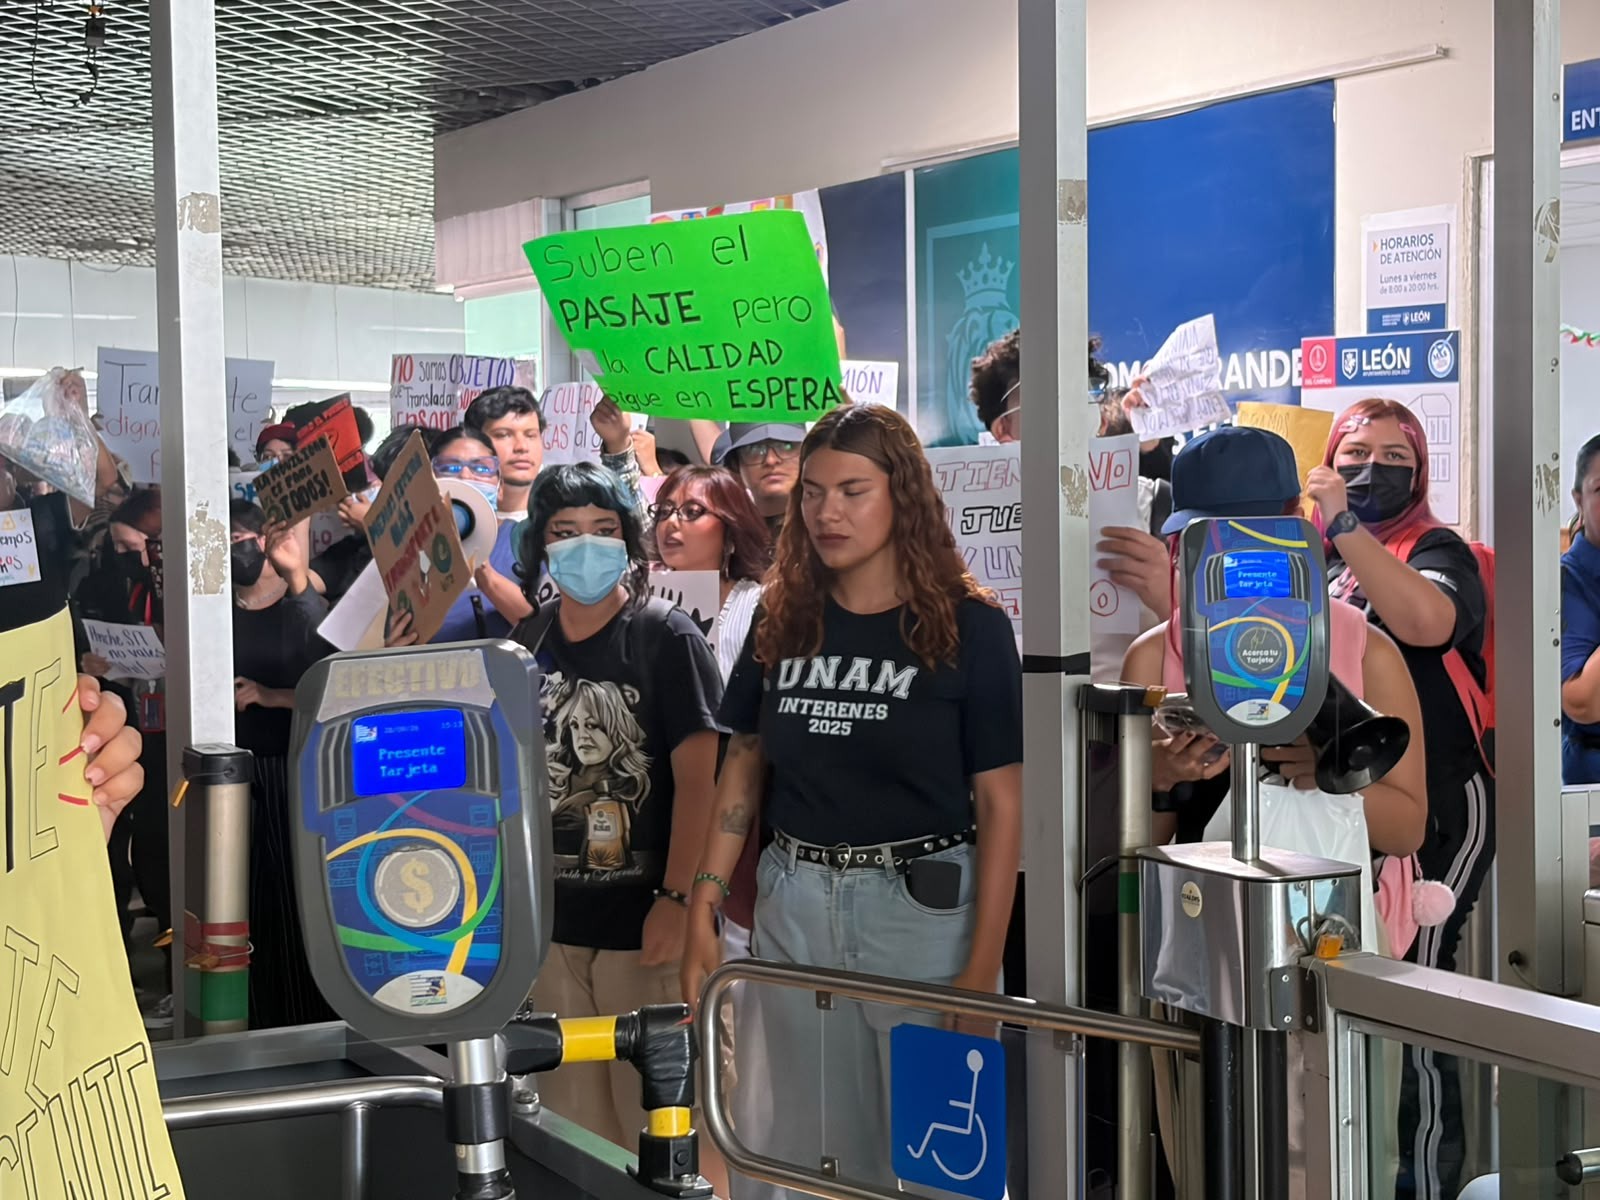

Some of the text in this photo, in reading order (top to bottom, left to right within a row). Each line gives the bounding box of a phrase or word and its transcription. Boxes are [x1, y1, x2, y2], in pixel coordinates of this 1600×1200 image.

[1380, 233, 1434, 251] HORARIOS
[543, 224, 749, 282] Suben el
[1380, 246, 1442, 265] DE ATENCIÓN
[1380, 271, 1437, 284] Lunes a viernes
[558, 289, 812, 333] PASAJE pero
[1410, 309, 1431, 322] LEÓN
[603, 338, 784, 375] la CALIDAD
[1361, 342, 1411, 371] LEÓN
[675, 388, 713, 409] en
[727, 376, 843, 411] ESPERA
[105, 408, 160, 443] dign
[1242, 649, 1279, 657] Acerca tu
[1246, 656, 1274, 665] Tarjeta
[334, 660, 481, 699] EFECTIVO
[776, 656, 920, 700] UNAM
[777, 697, 889, 720] INTERENES
[808, 718, 853, 736] 2025
[378, 745, 446, 761] Presente
[380, 763, 438, 779] Tarjeta
